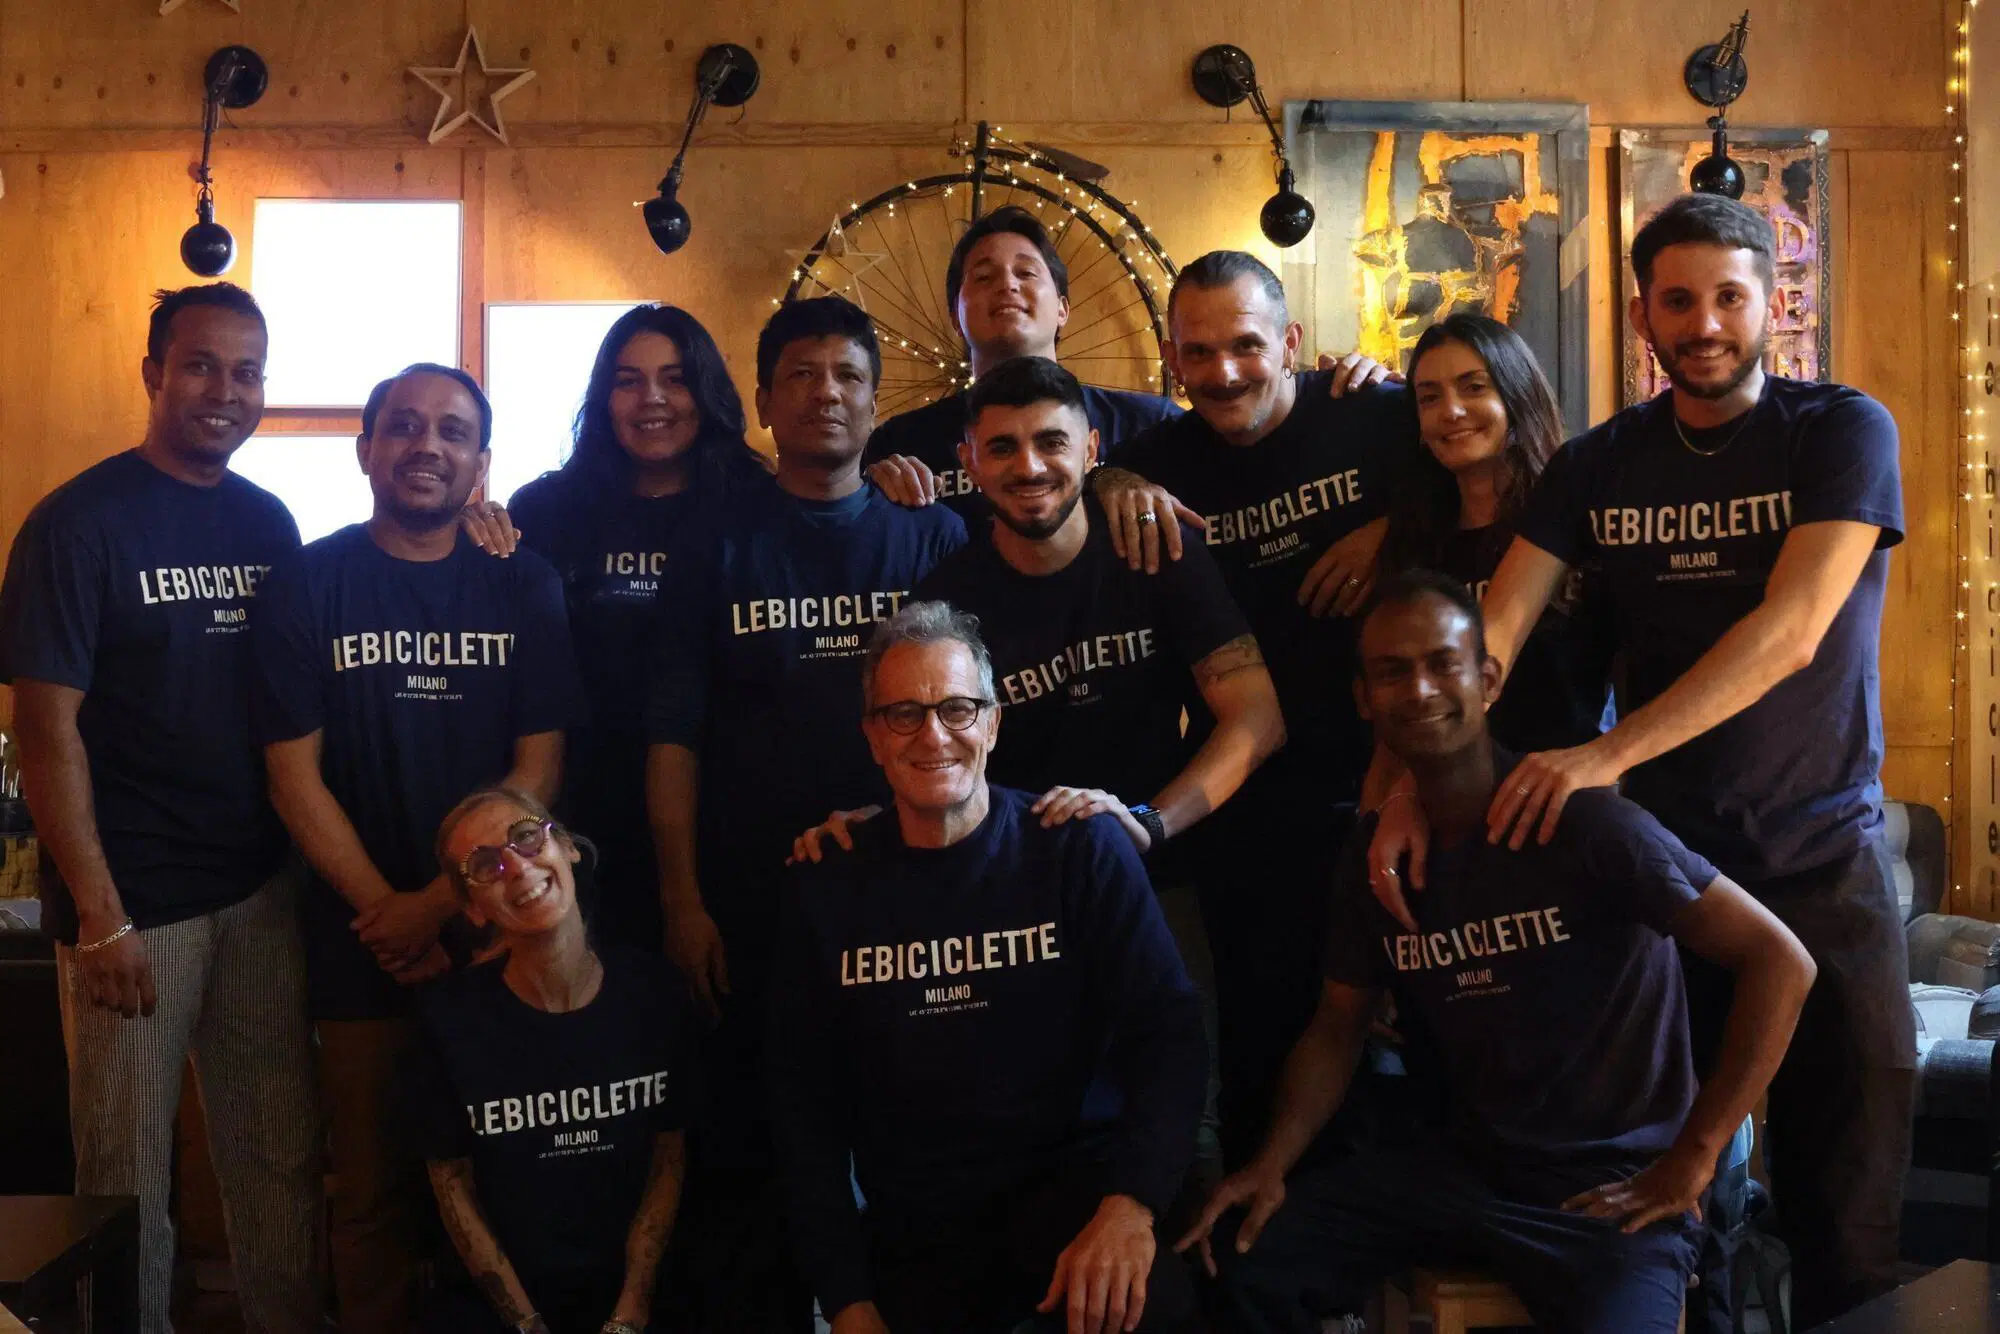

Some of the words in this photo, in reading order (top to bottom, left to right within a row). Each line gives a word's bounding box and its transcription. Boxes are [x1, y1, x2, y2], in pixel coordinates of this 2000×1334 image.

[1205, 468, 1363, 546] EBICICLETTE
[1259, 532, 1300, 557] MILANO
[1670, 551, 1718, 569] MILANO
[213, 607, 247, 624] MILANO
[732, 590, 910, 635] LEBICICLET
[332, 630, 515, 672] LEBICICLETT
[815, 634, 859, 649] MILANO
[407, 675, 447, 690] MILANO
[841, 922, 1061, 986] LEBICICLETTE
[925, 984, 971, 1004] MILANO
[467, 1070, 668, 1136] LEBICICLETTE
[554, 1129, 599, 1148] MILANO
